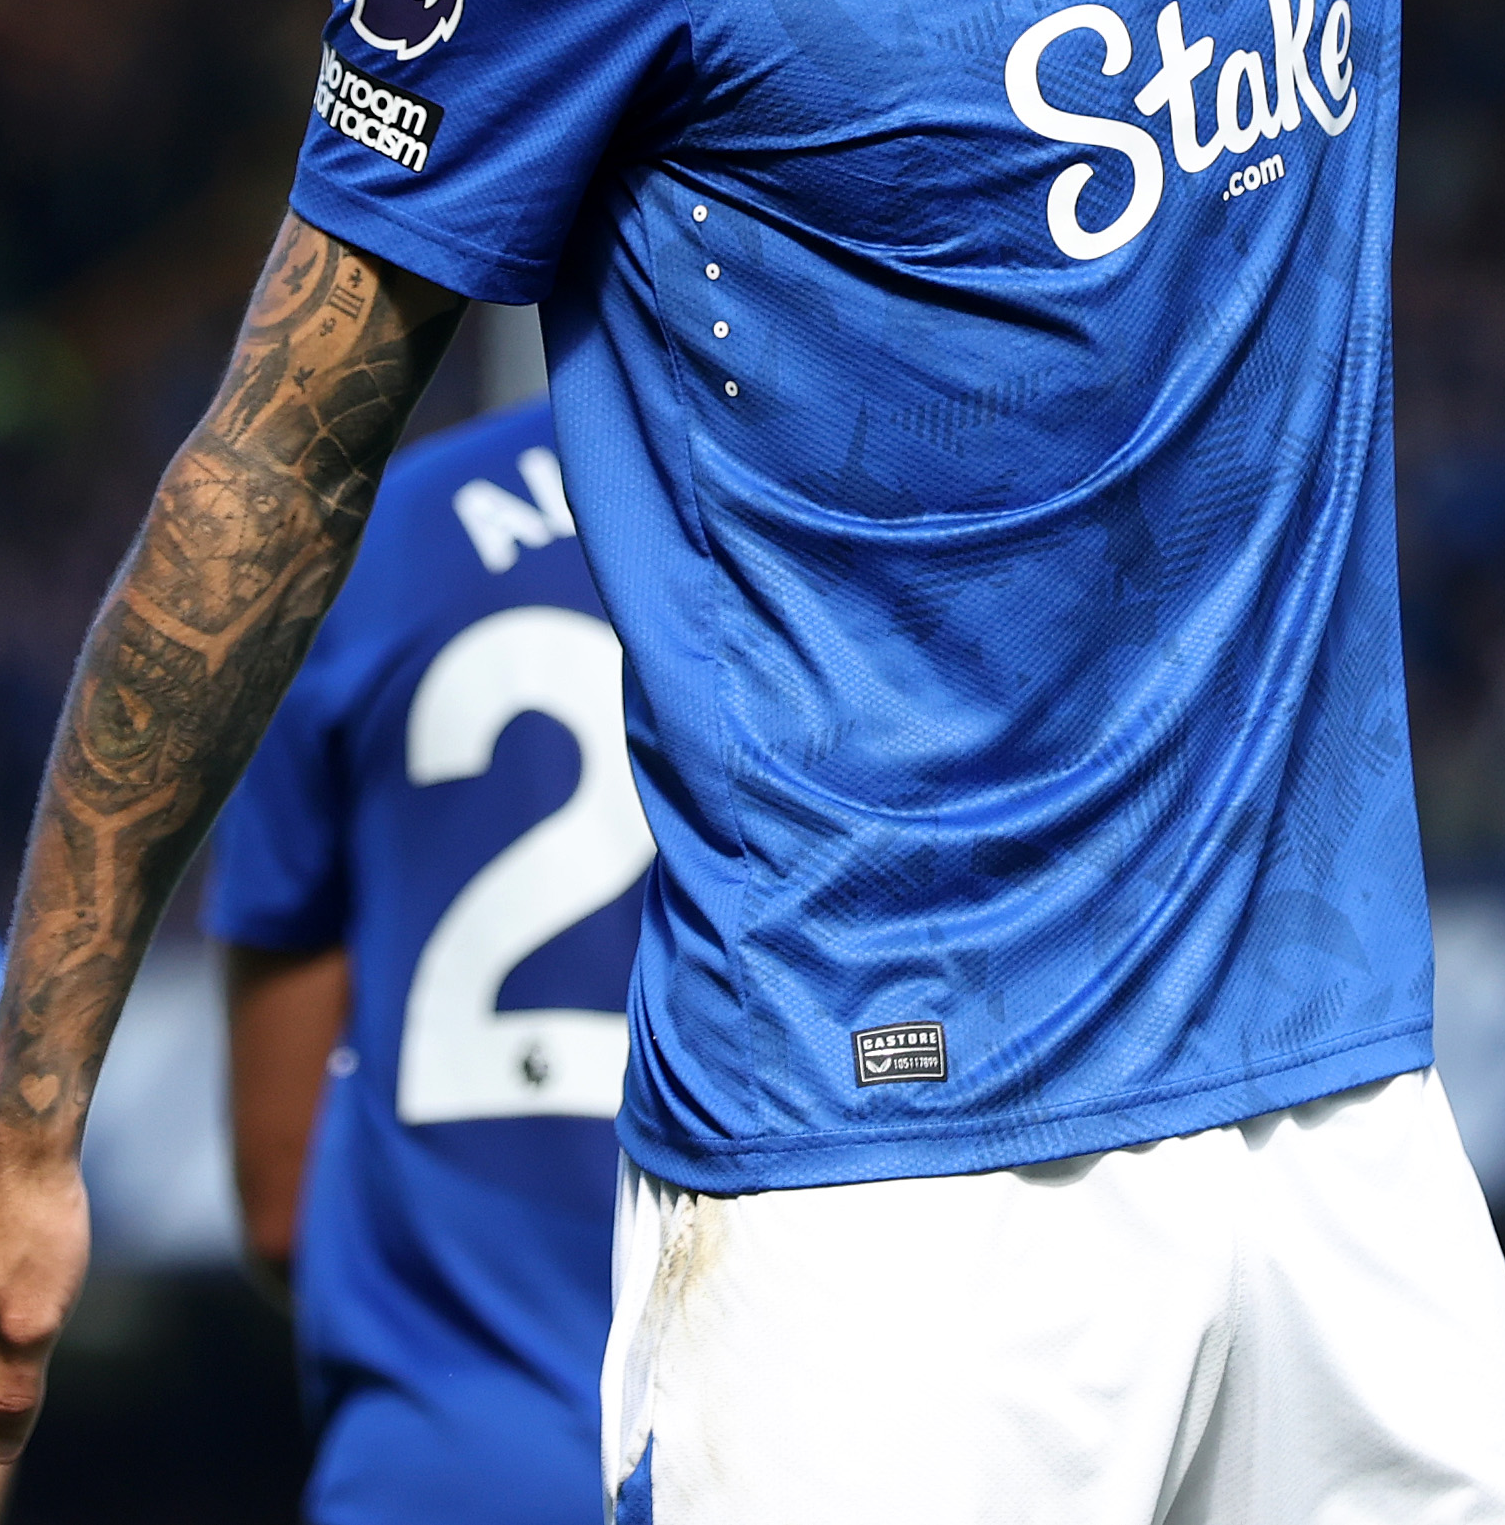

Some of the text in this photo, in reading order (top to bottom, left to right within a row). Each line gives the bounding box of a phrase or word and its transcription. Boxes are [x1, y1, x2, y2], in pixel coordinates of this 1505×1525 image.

[339, 70, 427, 137] room
[329, 99, 428, 172] racism
[1222, 154, 1285, 201] .com
[863, 1032, 937, 1049] CASTORE
